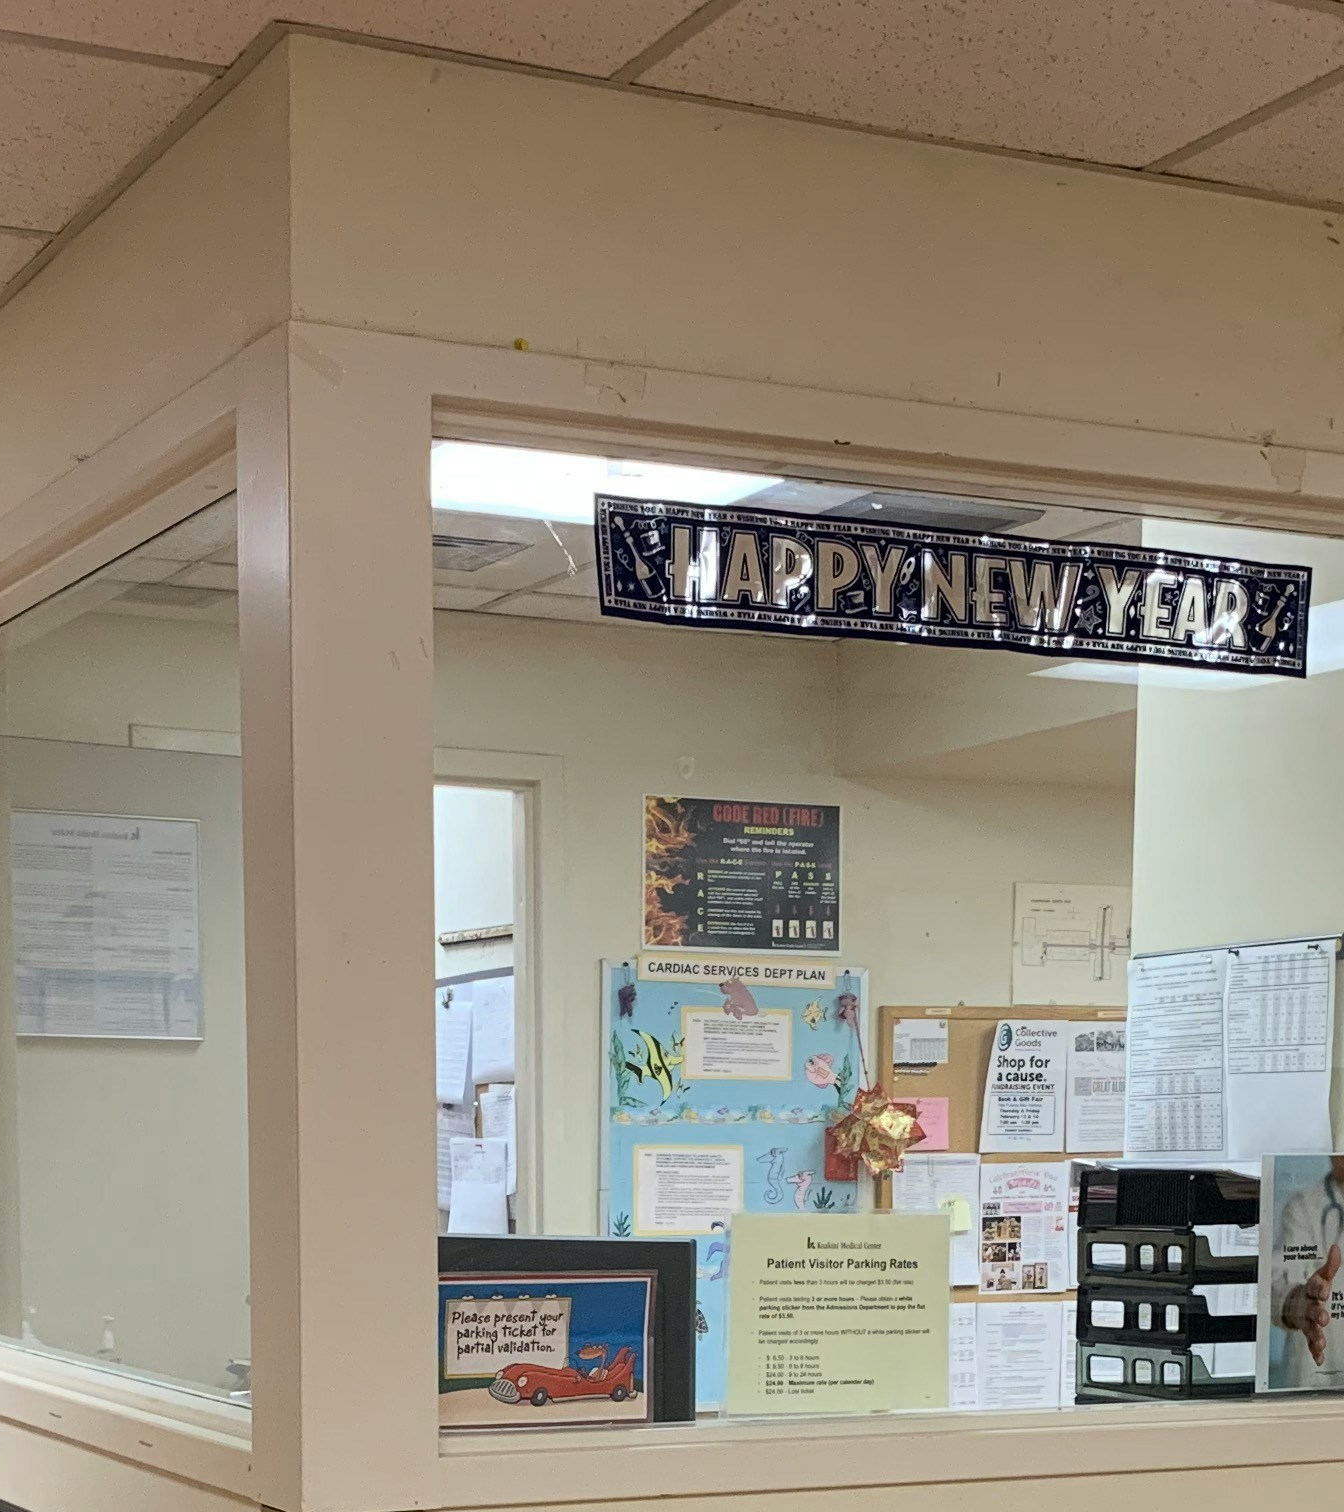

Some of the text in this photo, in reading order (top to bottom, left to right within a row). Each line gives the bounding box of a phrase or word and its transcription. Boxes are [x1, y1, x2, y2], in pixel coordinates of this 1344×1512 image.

[666, 507, 689, 517] HAPPY
[816, 522, 831, 530] NEW
[833, 524, 852, 532] YEAR
[860, 526, 890, 536] WISHING
[936, 534, 951, 543] NEW
[952, 536, 970, 544] YEAR
[666, 524, 908, 617] HAPPY
[921, 548, 1084, 633] NEW
[1093, 563, 1250, 652] YEAR
[713, 804, 824, 828] CODE RED (FIRE)
[744, 826, 794, 836] REMINDERS
[697, 872, 704, 880] R
[776, 870, 832, 880] P A S S
[697, 889, 704, 898] A
[697, 908, 704, 916] C
[697, 924, 704, 932] E
[648, 962, 826, 980] CARDIAC SERVICES DEPT PLAN
[1016, 1028, 1058, 1037] Collective
[1015, 1038, 1042, 1047] Goods
[997, 1056, 1050, 1071] Shop for
[997, 1072, 1047, 1082] a cause.
[1284, 1254, 1296, 1262] your
[767, 1258, 918, 1271] Patient Visitor Parking Rates
[1332, 1291, 1343, 1300] It's
[452, 1309, 564, 1327] Please present your
[456, 1324, 556, 1344] parking ticket for
[457, 1339, 556, 1360] partial validation.
